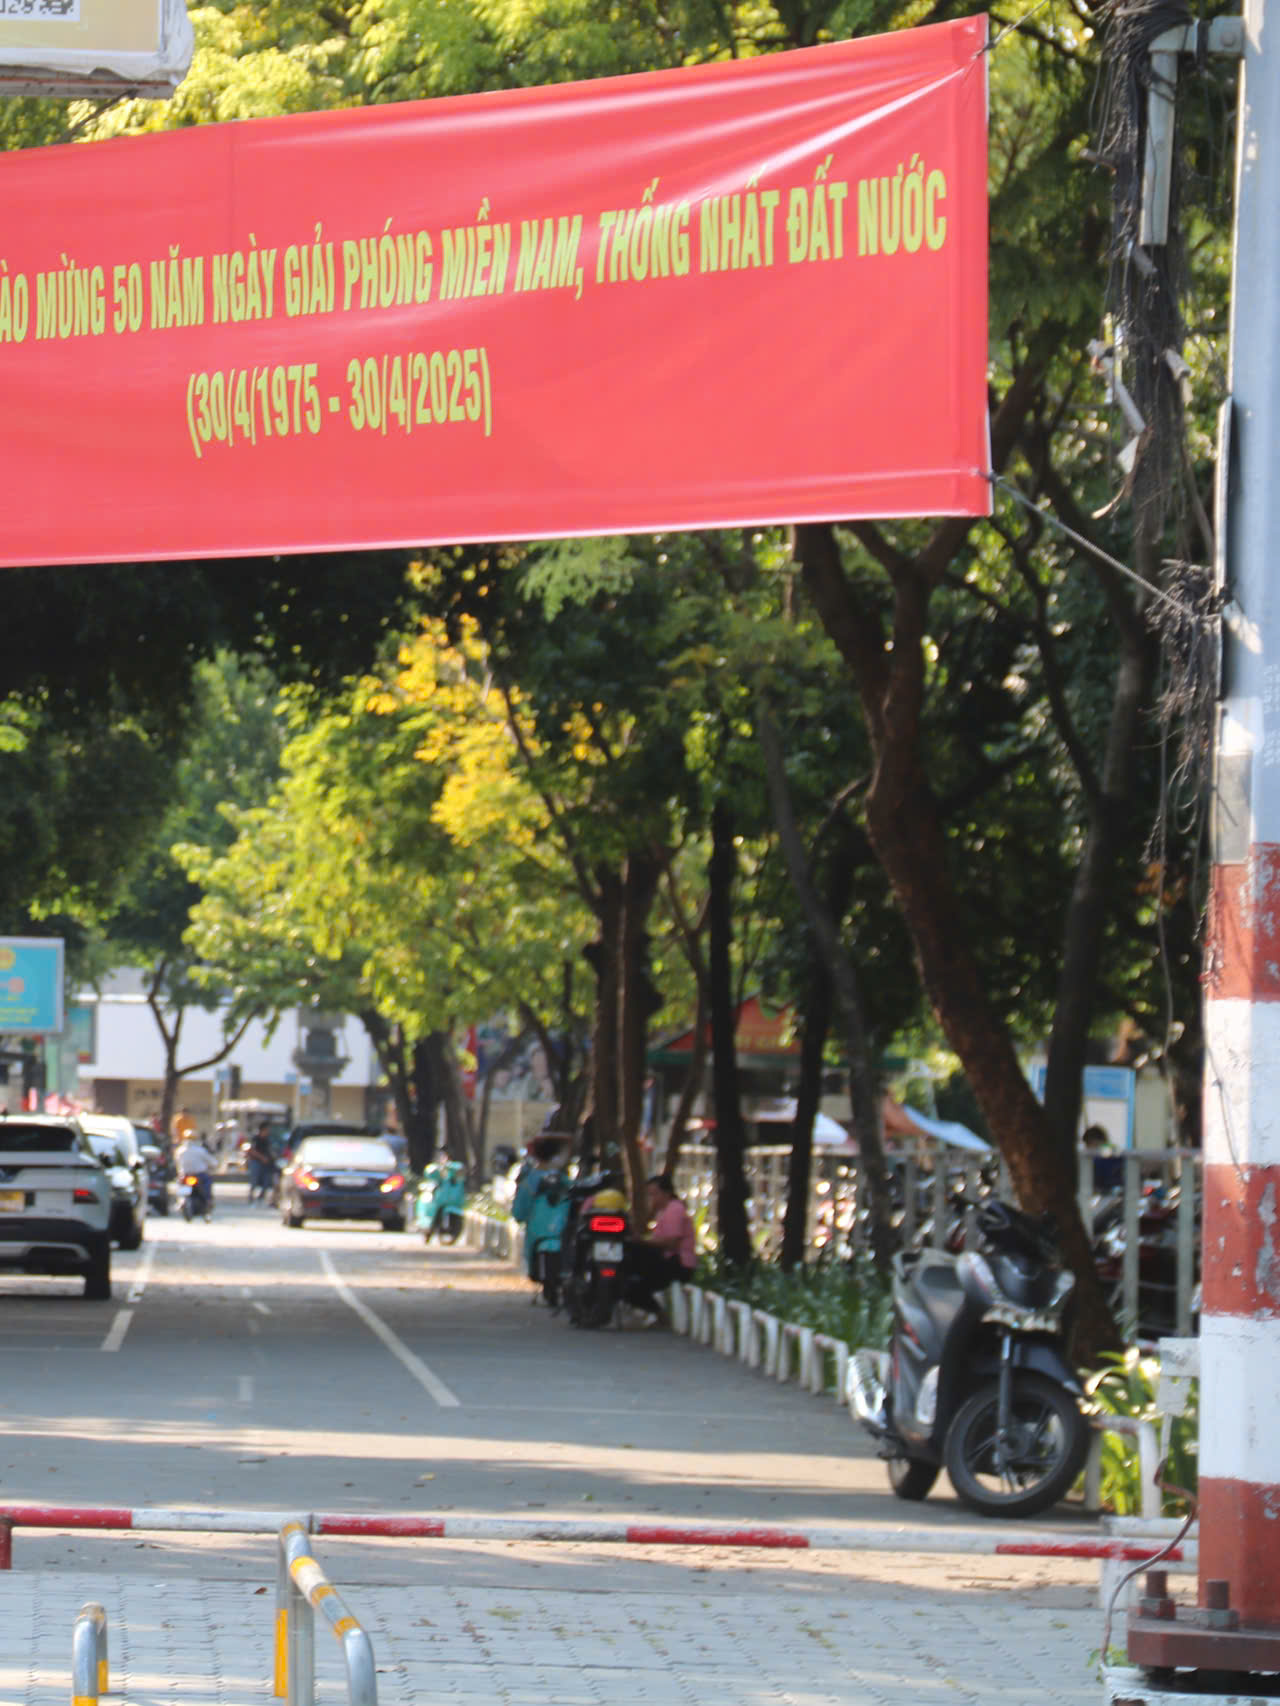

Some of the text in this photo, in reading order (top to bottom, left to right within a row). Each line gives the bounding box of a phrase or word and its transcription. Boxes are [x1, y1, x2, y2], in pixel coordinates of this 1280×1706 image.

[36, 253, 105, 339] MỪNG
[113, 263, 143, 333] 50
[150, 244, 204, 328] NĂM
[212, 233, 277, 323] NGÀY
[284, 222, 334, 317] GIẢI
[343, 217, 432, 311] PHÓNG
[439, 198, 511, 300] MIỀN
[514, 214, 583, 300] NAM,
[596, 177, 690, 283] THỐNG
[700, 164, 780, 273] NHẤT
[787, 155, 848, 264] ĐẤT
[858, 152, 947, 256] NƯỚC
[187, 363, 320, 458] (30/4/1975
[347, 347, 492, 436] 30/4/2025)
